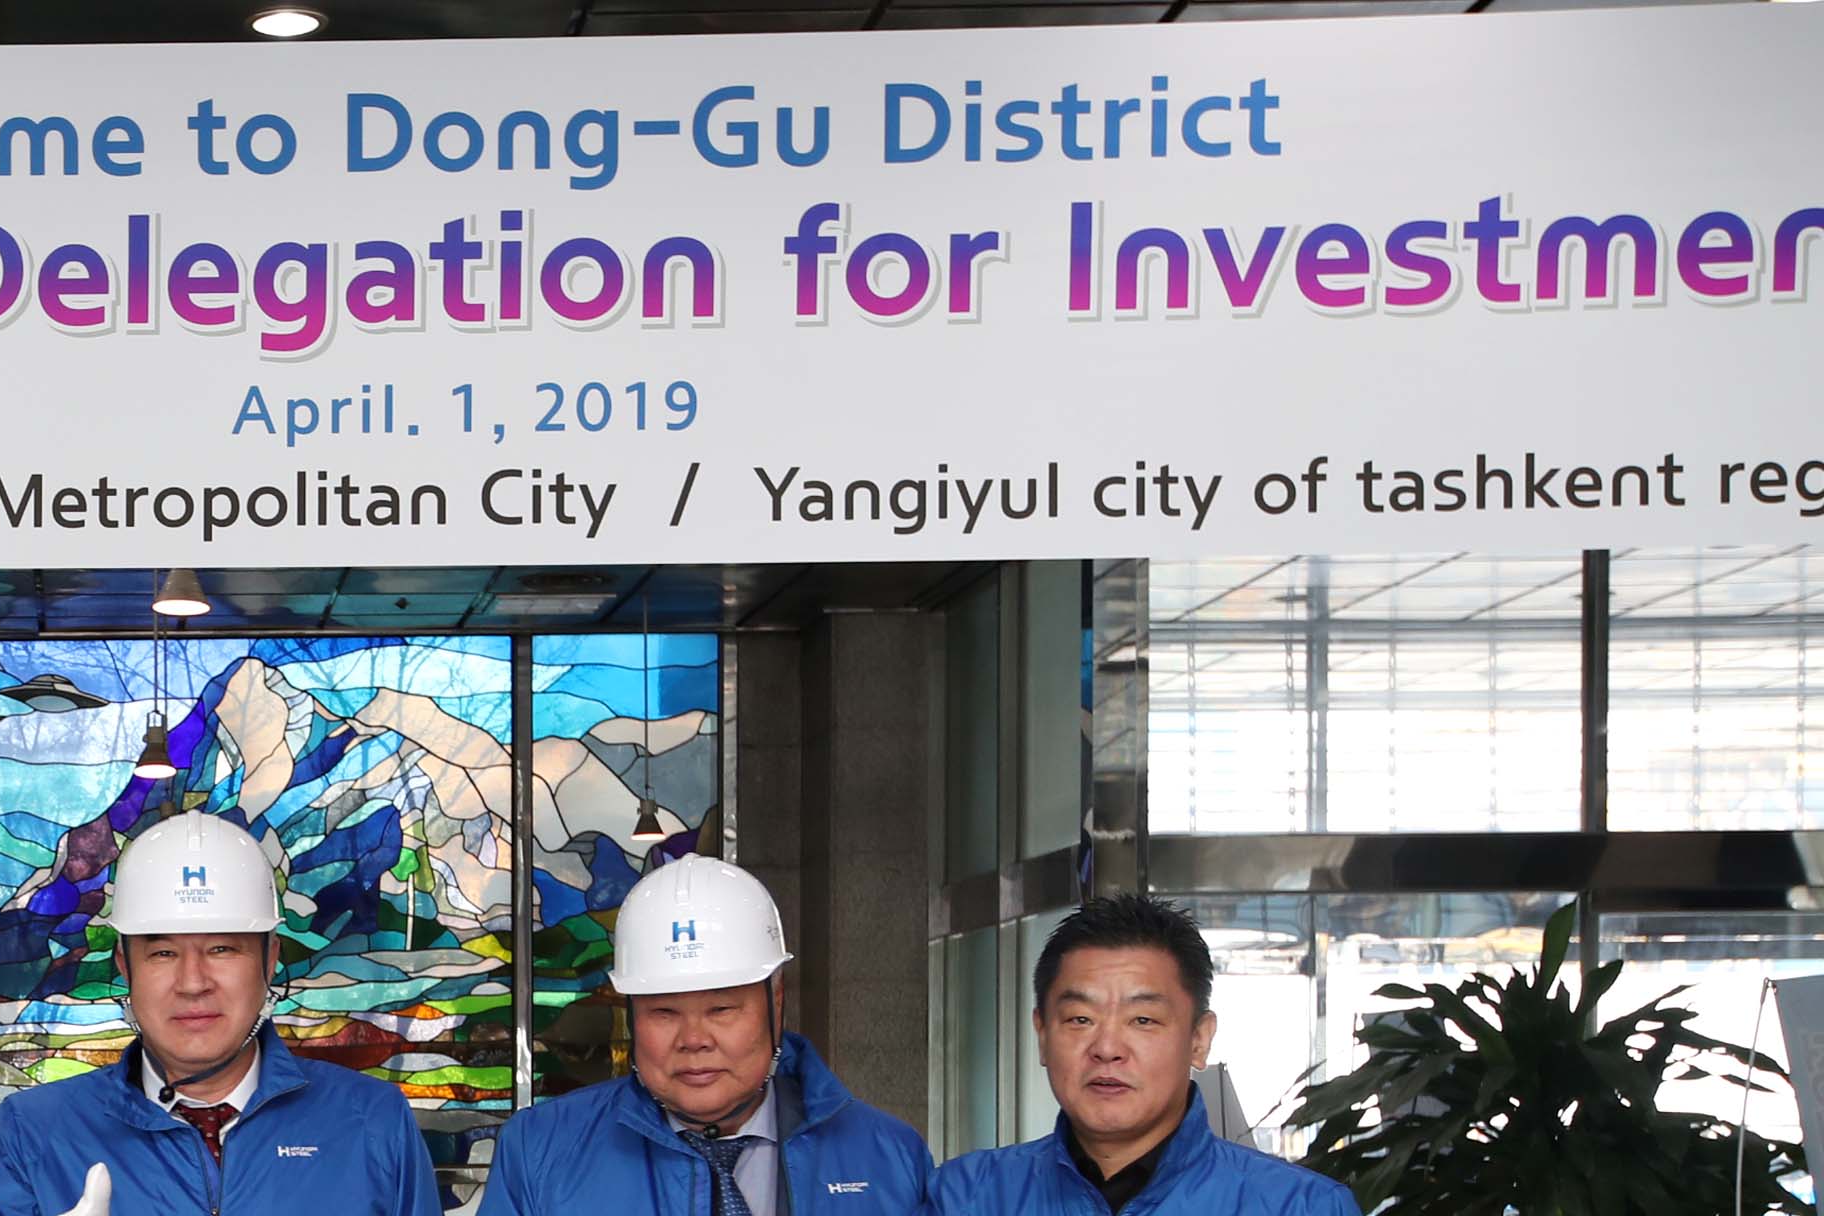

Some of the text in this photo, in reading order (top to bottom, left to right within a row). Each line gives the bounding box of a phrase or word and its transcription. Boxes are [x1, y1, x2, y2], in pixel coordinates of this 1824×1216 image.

[188, 100, 296, 174] to
[348, 86, 829, 189] Dong-Gu
[886, 76, 1280, 162] District
[785, 204, 998, 315] for
[1070, 197, 1824, 310] Investmen
[234, 382, 696, 446] April. 1, 2019
[482, 469, 616, 538] City
[670, 463, 699, 526] /
[754, 463, 1057, 534] Yangiyul
[1094, 461, 1221, 530] city
[1255, 457, 1328, 514] of
[1356, 453, 1685, 512] tashkent
[1721, 461, 1824, 517] reg
[174, 888, 215, 896] HYUNDAI
[183, 866, 206, 887] H
[179, 896, 209, 904] STEEL
[672, 920, 696, 943] H
